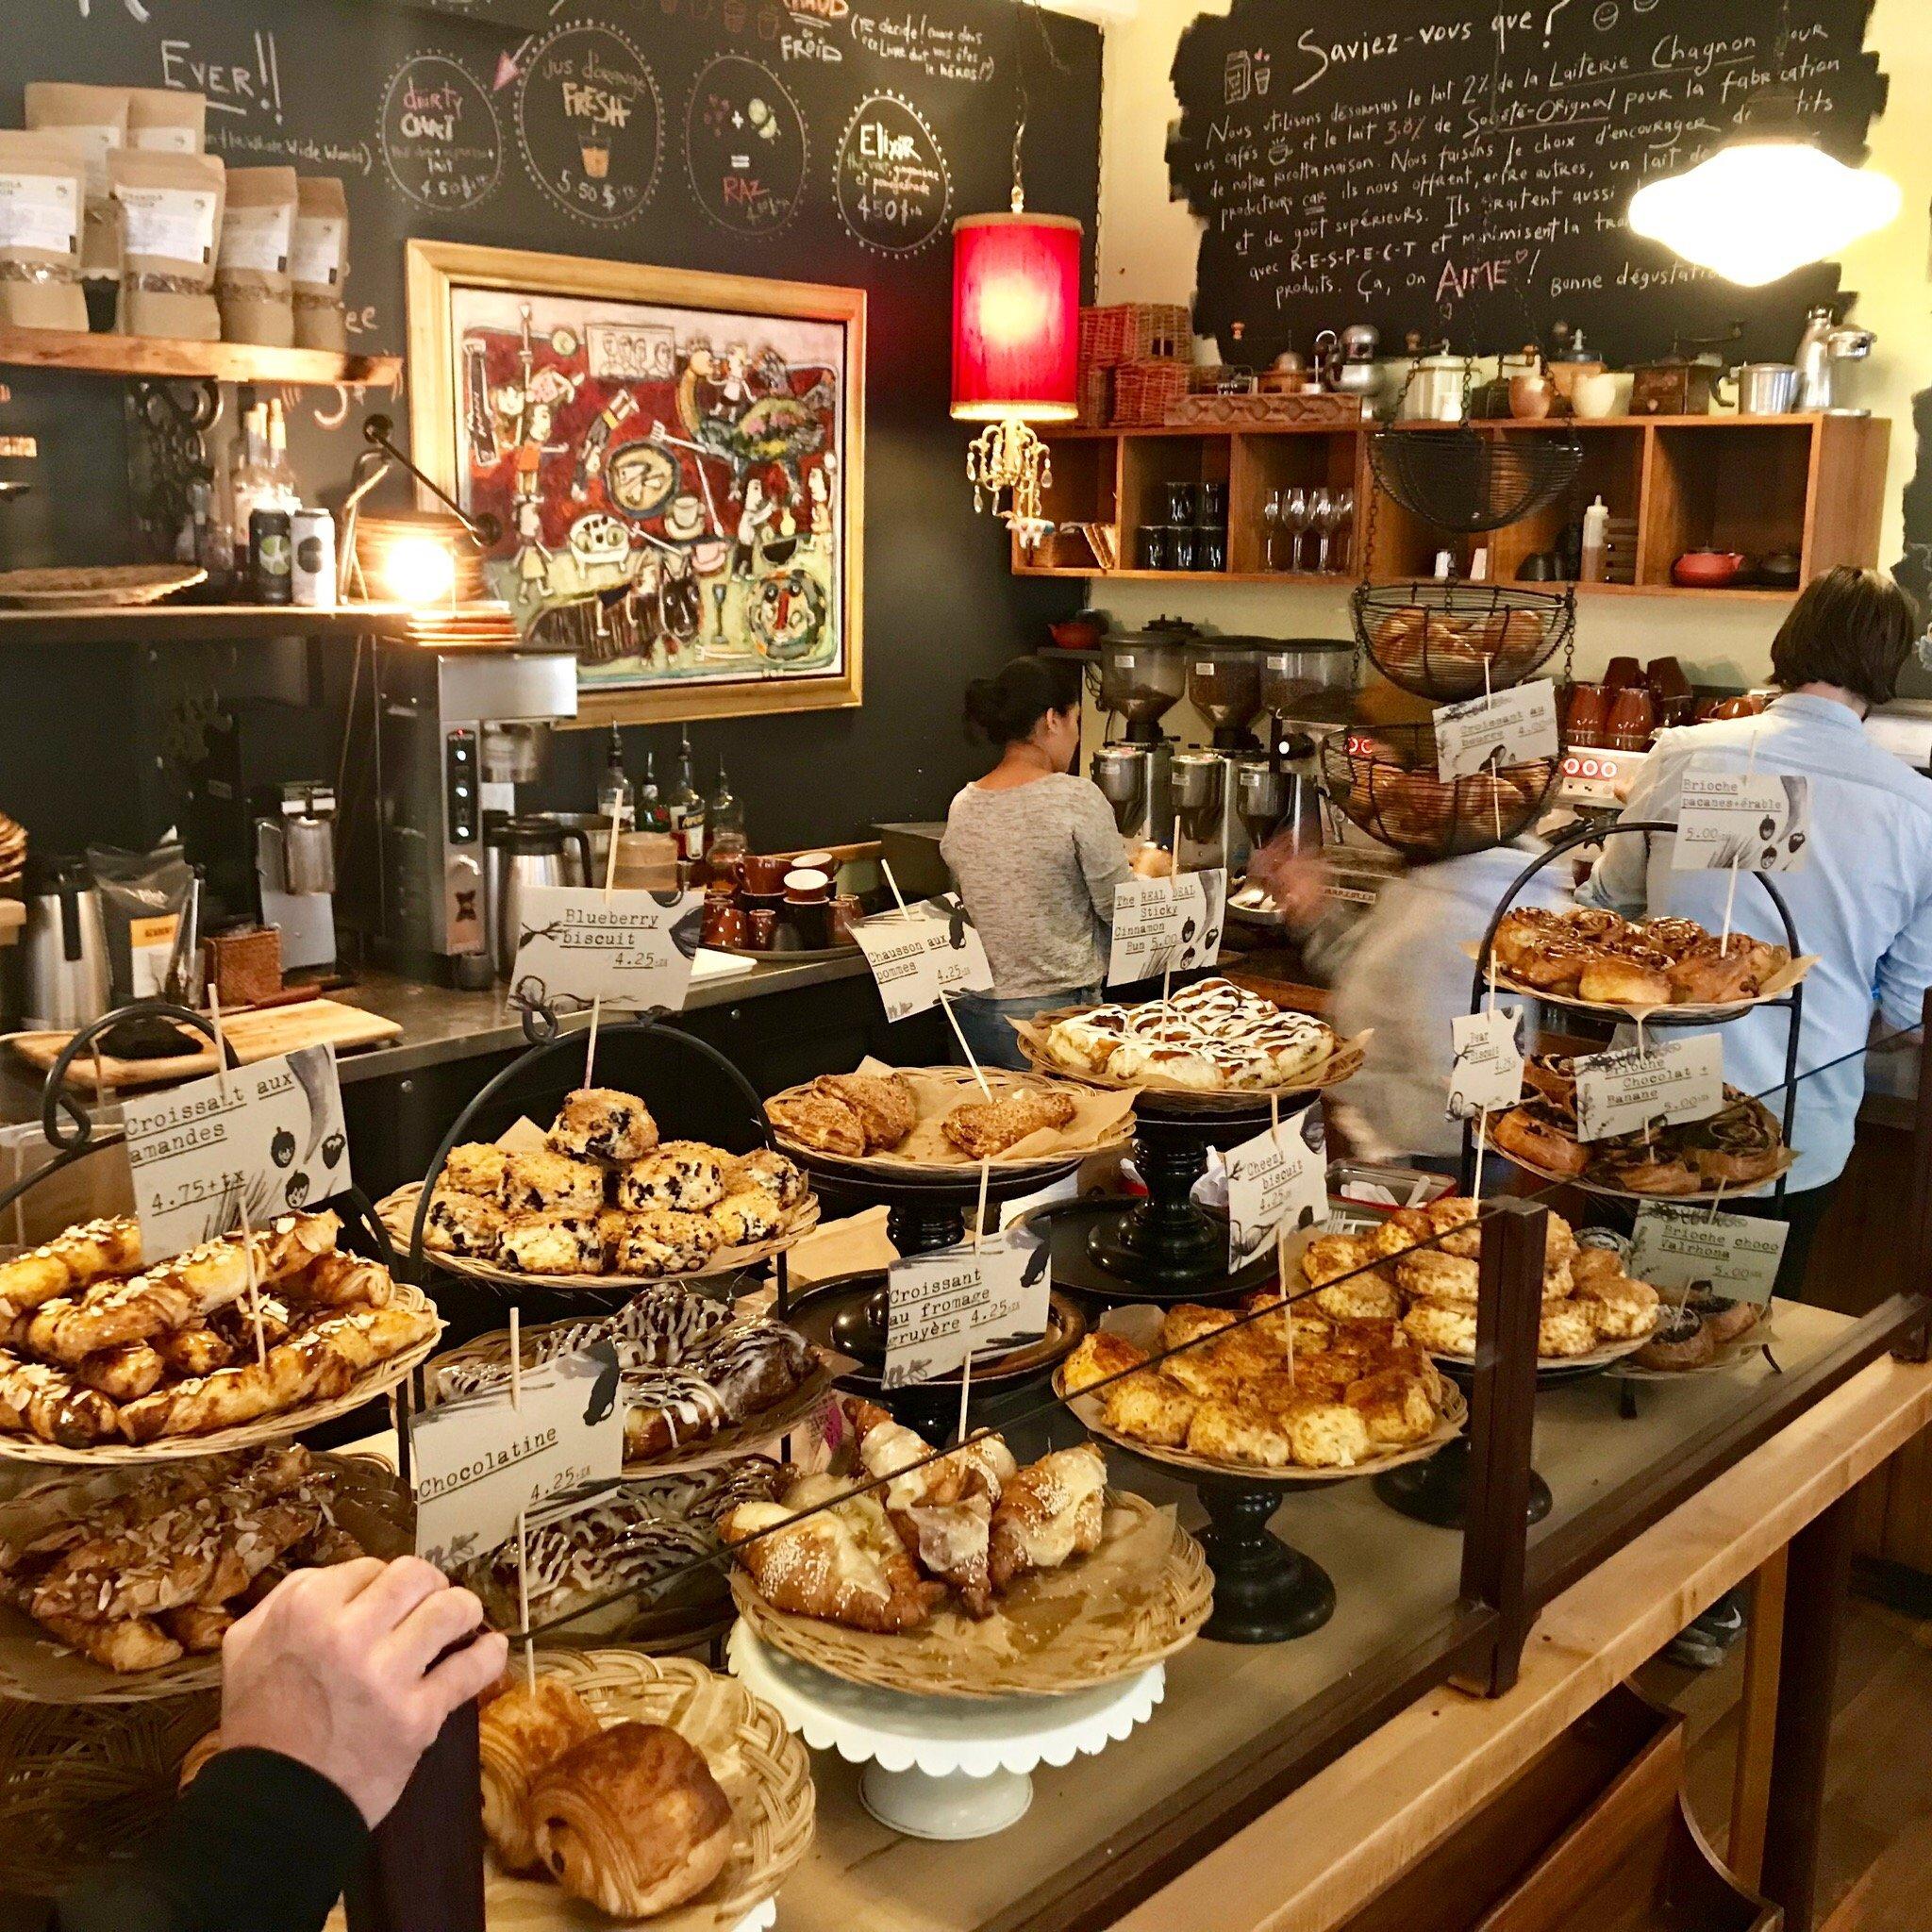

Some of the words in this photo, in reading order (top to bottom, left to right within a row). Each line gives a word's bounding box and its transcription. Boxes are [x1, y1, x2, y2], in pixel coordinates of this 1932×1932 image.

[1292, 25, 1472, 94] Saviez-vous
[1491, 10, 1533, 55] que
[561, 81, 633, 129] FRESH
[1206, 114, 1253, 151] Nous
[1262, 108, 1321, 133] utilisons
[1330, 101, 1398, 124] désormais
[1407, 88, 1422, 109] le
[1429, 79, 1457, 106] lait
[1461, 74, 1490, 105] 2%
[1496, 72, 1514, 93] de
[1523, 67, 1539, 89] la
[1549, 51, 1629, 88] Laiterie
[1651, 33, 1757, 77] Chagnon
[1224, 144, 1259, 171] cafés
[1302, 132, 1319, 152] et
[1324, 126, 1338, 149] le
[1347, 121, 1378, 143] lait
[1434, 114, 1453, 134] de
[1624, 88, 1673, 115] pour
[1686, 78, 1705, 99] la
[1209, 178, 1225, 199] de
[1232, 171, 1266, 193] notre
[1390, 147, 1428, 174] Nous
[1438, 140, 1494, 172] faisons
[1507, 136, 1523, 166] le
[1535, 132, 1575, 155] choix
[1594, 116, 1723, 150] d'encourager
[1220, 192, 1293, 233] producteurs
[1301, 191, 1328, 208] car
[1341, 179, 1359, 200] ils
[1365, 179, 1399, 196] nous
[1534, 158, 1595, 180] autres,
[1608, 158, 1631, 172] un
[1642, 146, 1683, 174] lait
[1233, 227, 1256, 252] et
[1263, 229, 1284, 248] de
[1291, 216, 1329, 254] goût
[1443, 192, 1472, 229] Ils
[1572, 185, 1615, 206] aussi
[1249, 260, 1280, 282] avec
[1430, 232, 1454, 256] et
[1562, 216, 1580, 237] la
[1405, 272, 1427, 288] on
[1550, 274, 1604, 299] Bonne
[1683, 779, 1739, 791] Brioche
[1116, 895, 1136, 907] The
[1141, 889, 1166, 903] REAL
[1172, 884, 1196, 899] DEAL
[565, 908, 659, 928] Blueberry
[1141, 904, 1178, 919] Sticky
[562, 929, 636, 945] biscuit
[1114, 921, 1166, 938] Cinnamon
[867, 940, 924, 964] Chausson
[926, 933, 948, 947] aux
[1125, 941, 1146, 952] Bun
[875, 959, 918, 982] pommes
[256, 1071, 294, 1097] aux
[1622, 1066, 1692, 1090] Chocolat
[1606, 1089, 1659, 1104] Banane
[128, 1121, 227, 1164] amandes
[150, 1169, 247, 1211] 4.75+tx
[1261, 1159, 1304, 1191] biscuit
[1660, 1239, 1731, 1260] Valrhona
[1663, 1224, 1726, 1244] Brioche
[1734, 1236, 1780, 1253] choco
[889, 1267, 983, 1305] Croissant
[888, 1309, 910, 1326] au
[920, 1288, 991, 1319] fromage
[418, 1425, 558, 1499] Chocolatine
